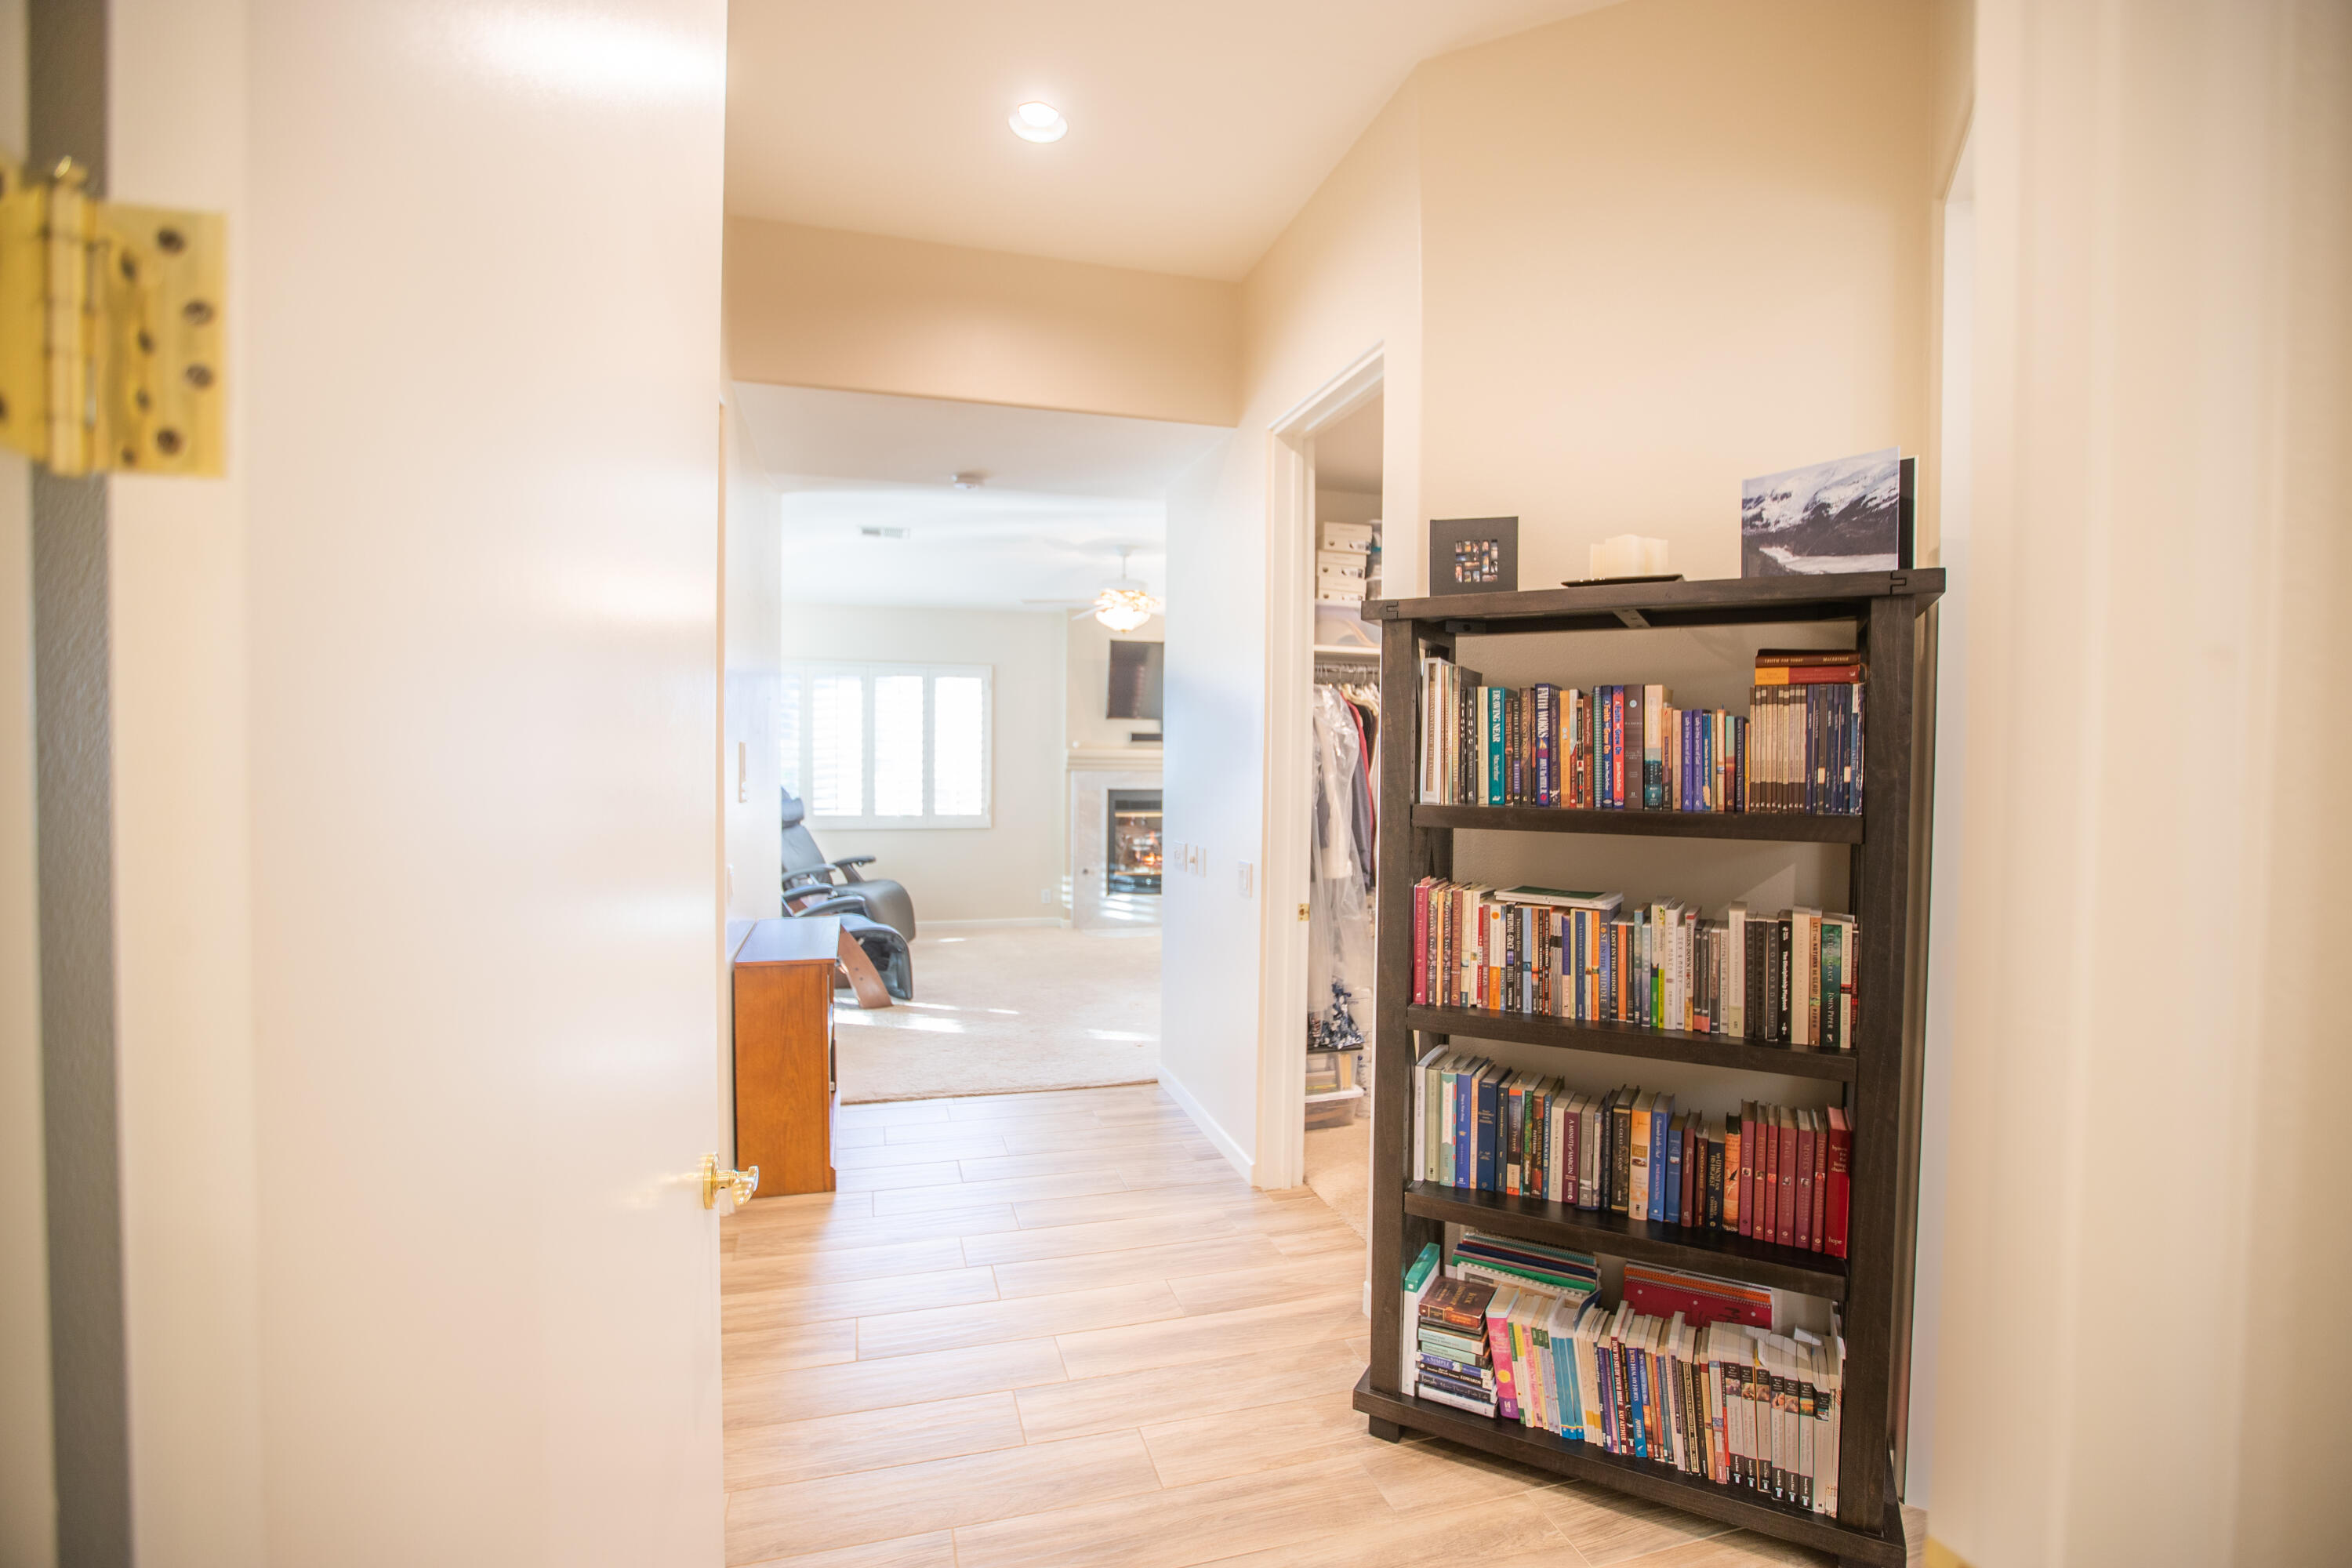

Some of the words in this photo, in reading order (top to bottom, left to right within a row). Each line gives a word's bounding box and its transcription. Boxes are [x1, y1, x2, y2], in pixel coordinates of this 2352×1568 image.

[1537, 688, 1548, 709] FAITH
[1537, 711, 1548, 738] WORKS
[1828, 1236, 1842, 1247] hope
